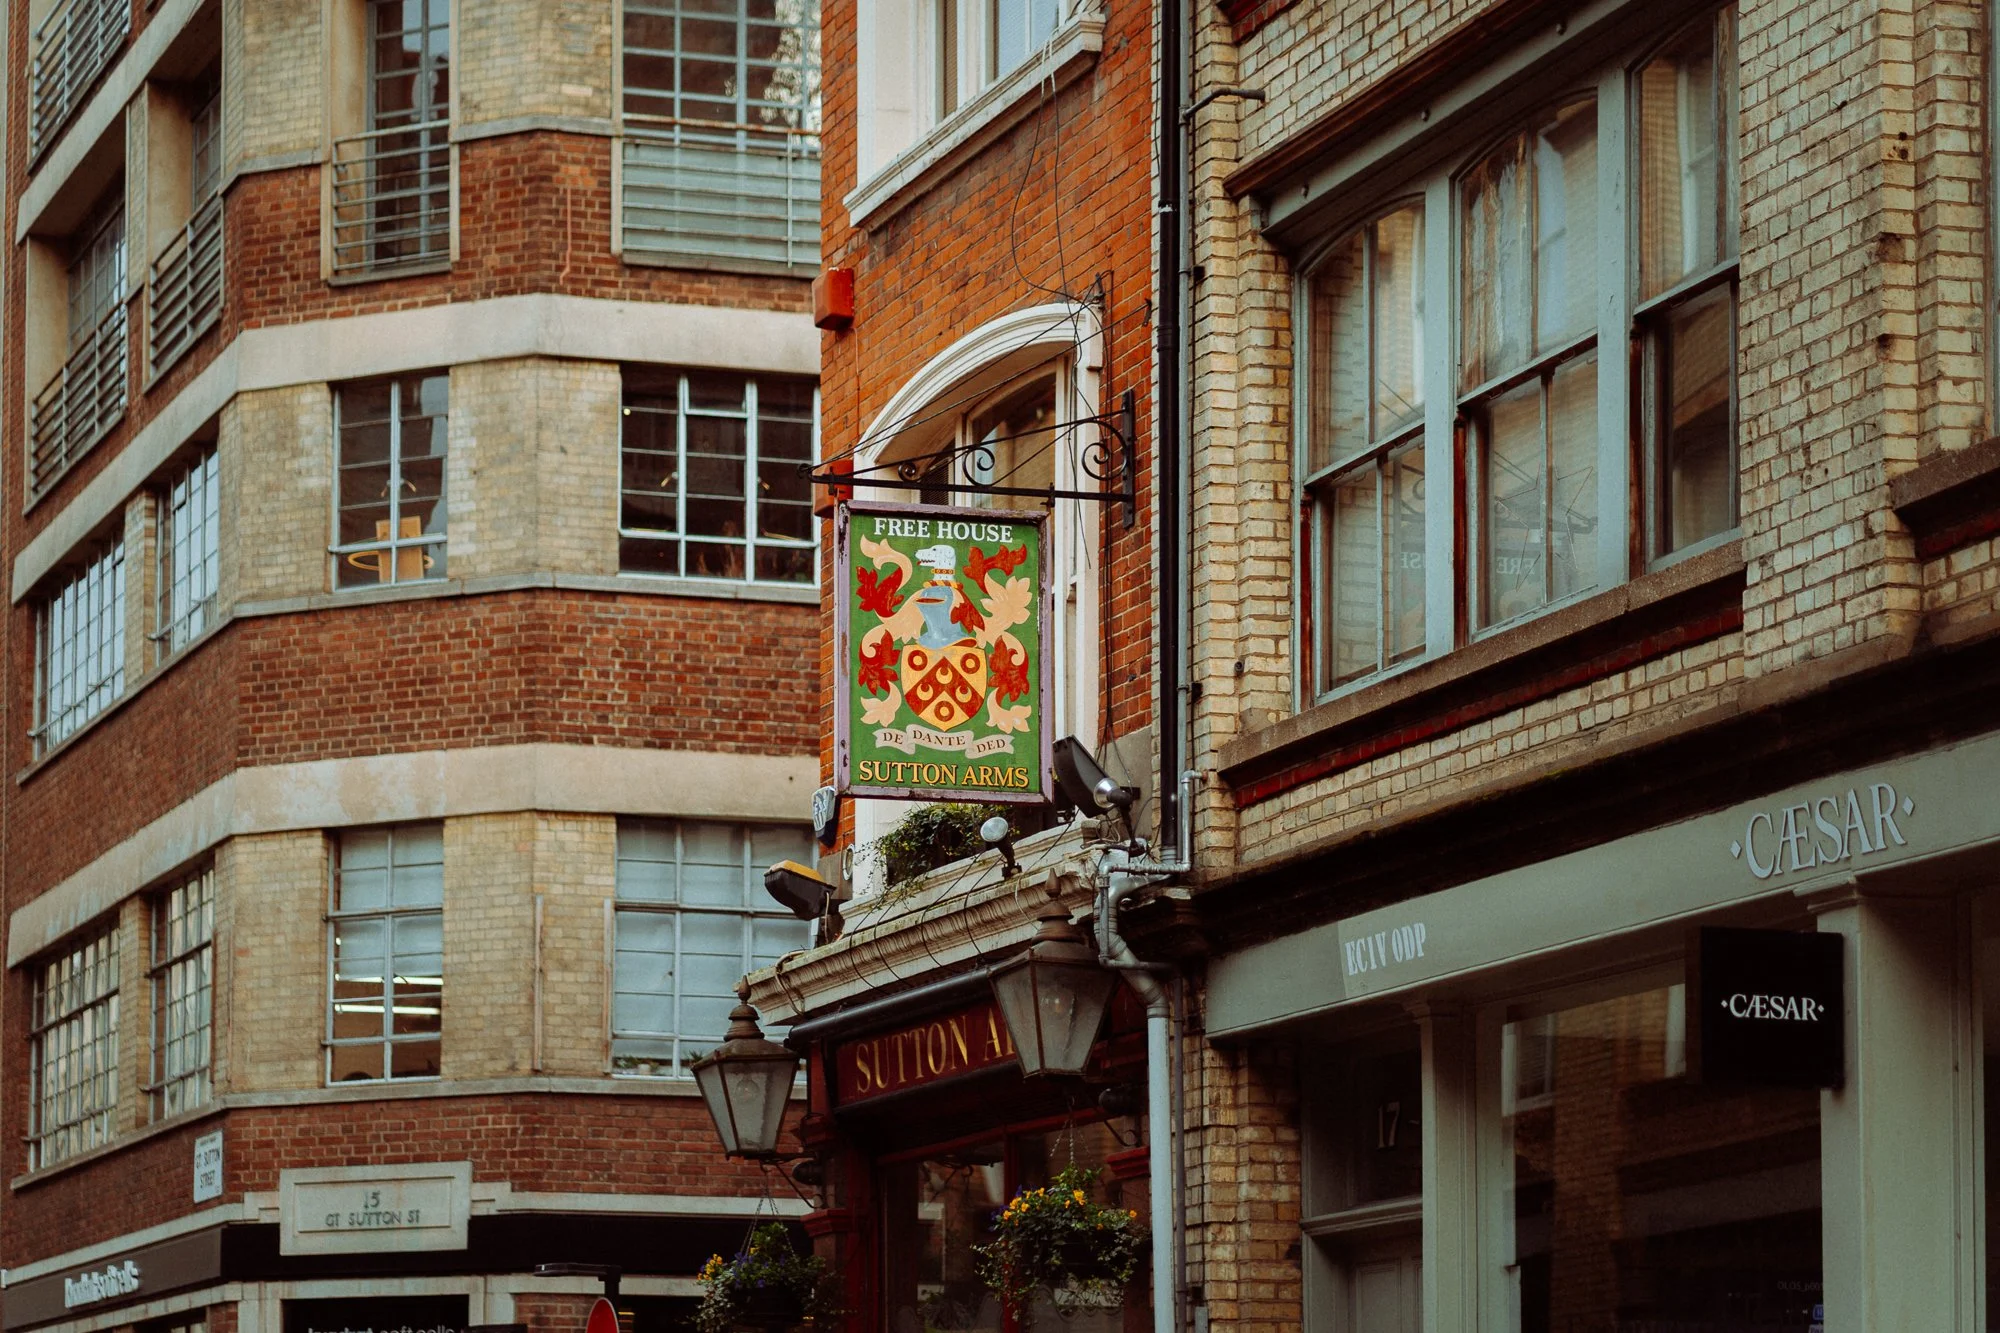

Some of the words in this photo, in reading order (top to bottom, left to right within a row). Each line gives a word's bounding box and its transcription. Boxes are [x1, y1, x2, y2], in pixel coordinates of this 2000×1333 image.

[873, 517, 931, 538] FREE
[937, 521, 1013, 543] HOUSE
[882, 731, 904, 745] DE
[912, 729, 966, 747] DANTE
[976, 738, 1006, 754] DED
[858, 760, 957, 785] SUTTON
[961, 764, 1029, 788] ARMS
[856, 1015, 969, 1094] SUTTON
[1376, 1101, 1401, 1149] 17
[363, 1190, 381, 1210] 15
[325, 1213, 340, 1228] GT
[348, 1210, 401, 1227] SUTTON
[407, 1209, 420, 1224] ST
